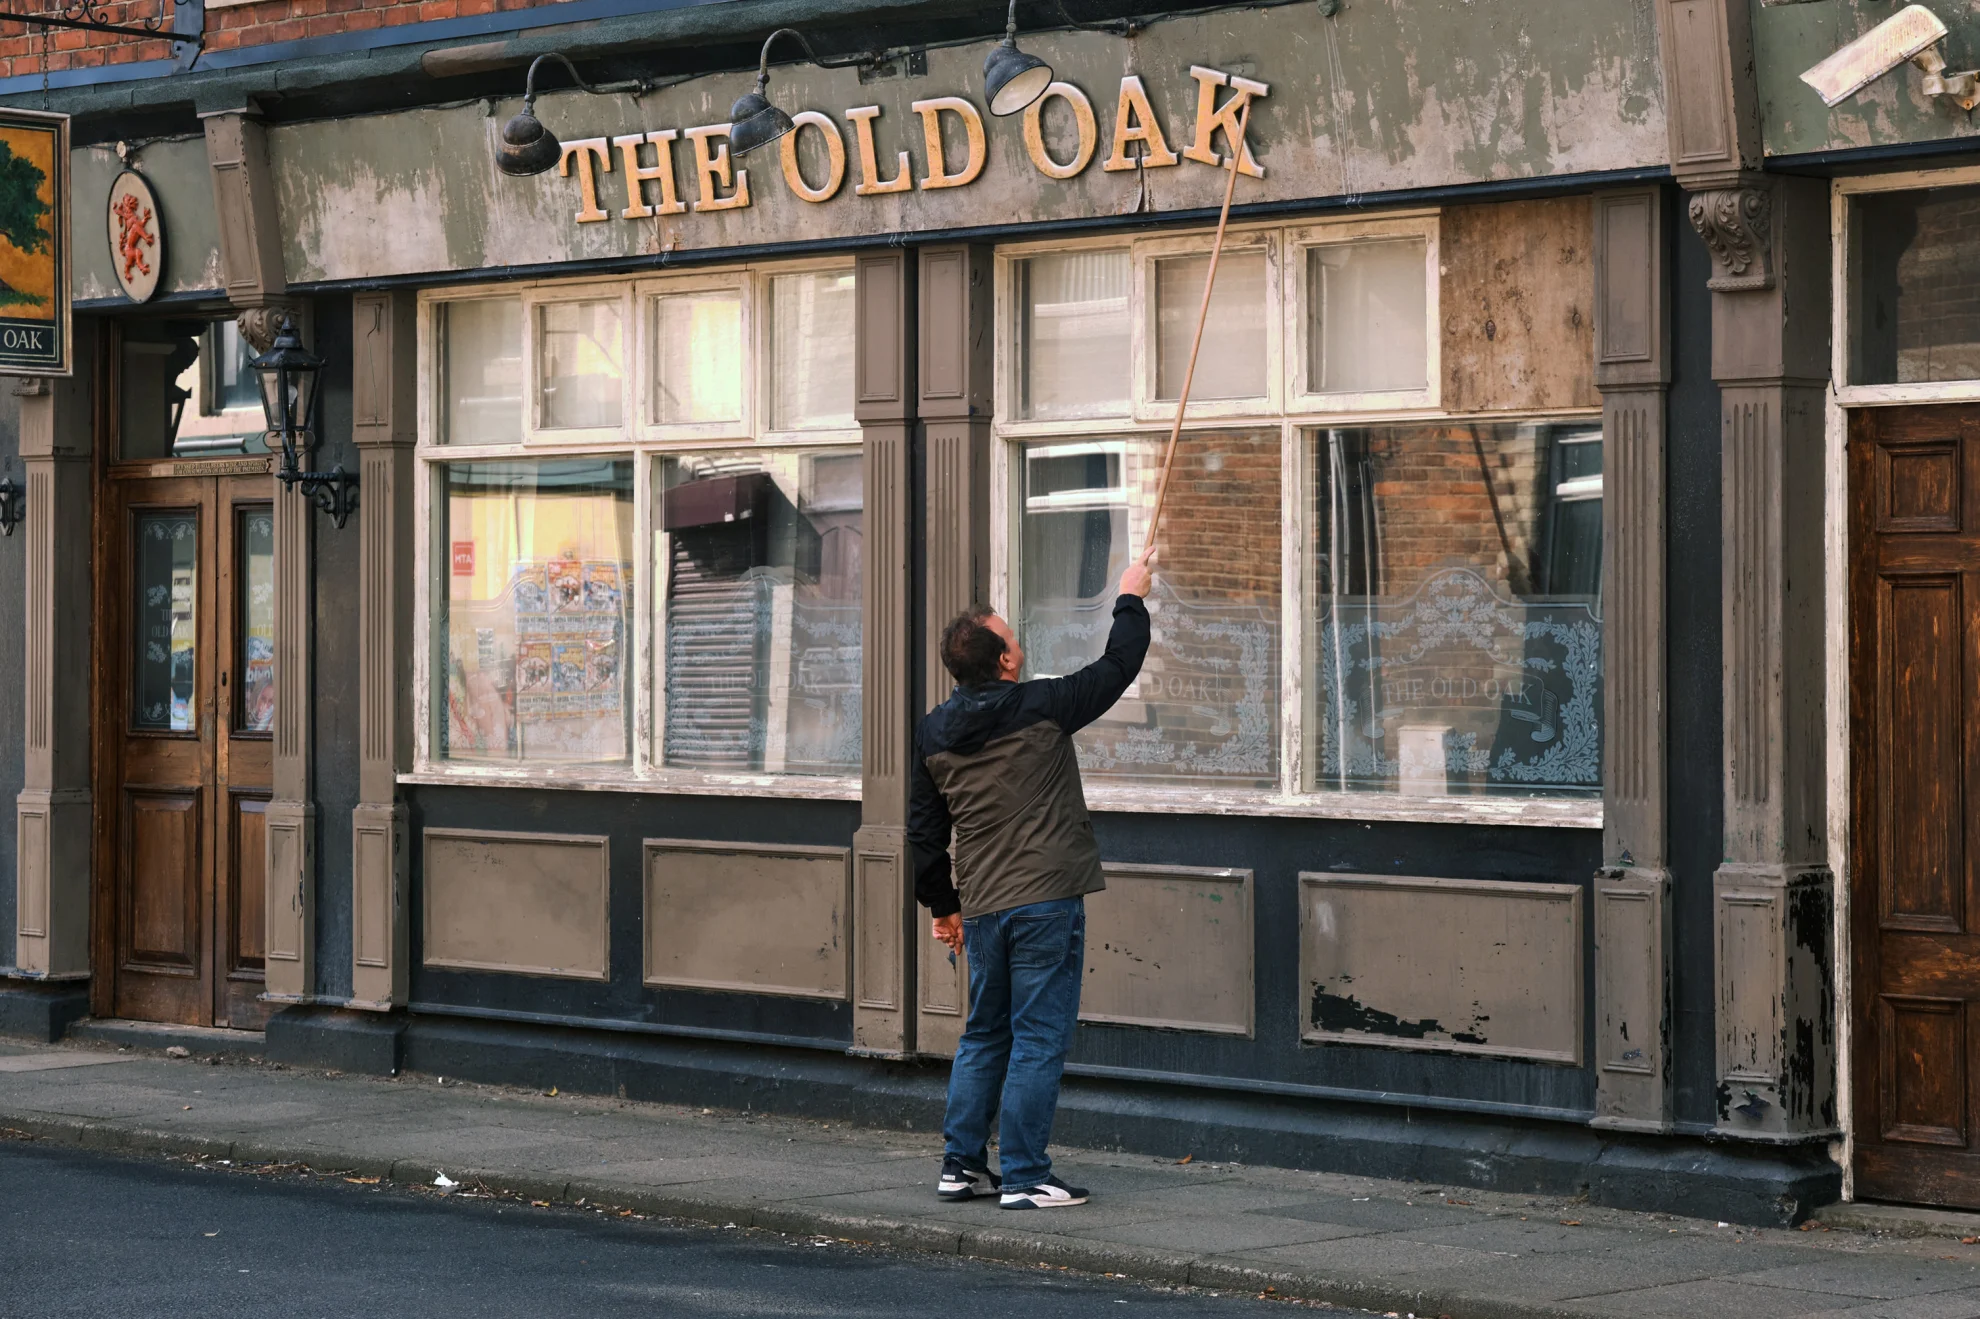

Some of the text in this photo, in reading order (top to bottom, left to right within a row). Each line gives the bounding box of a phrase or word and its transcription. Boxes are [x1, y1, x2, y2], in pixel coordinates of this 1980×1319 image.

[558, 64, 1270, 223] THE OLD OAK
[3, 328, 43, 350] OAK
[1168, 675, 1213, 702] OAK
[1380, 676, 1534, 705] THE OLD OAK
